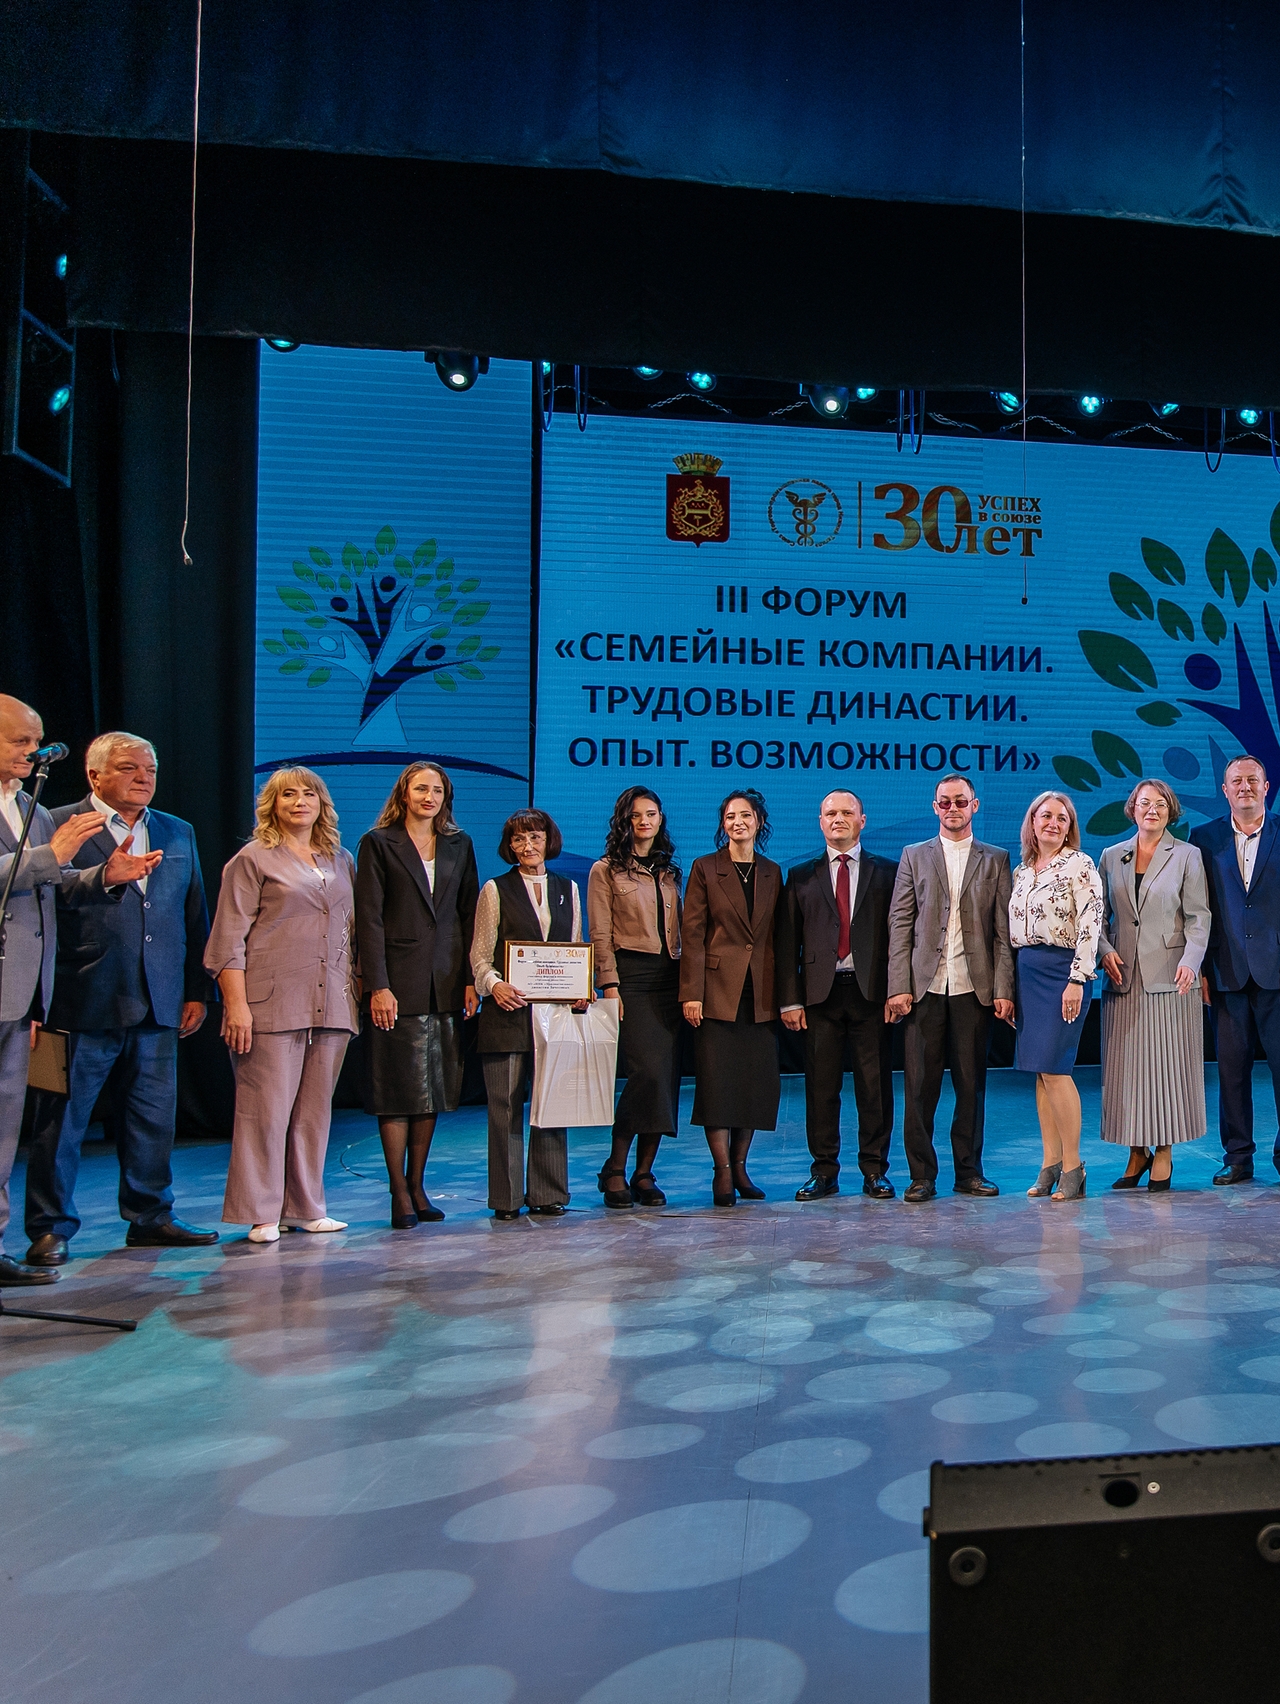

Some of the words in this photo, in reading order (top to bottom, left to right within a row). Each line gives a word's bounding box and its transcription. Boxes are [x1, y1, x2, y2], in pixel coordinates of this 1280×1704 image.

[870, 482, 973, 553] 30
[954, 524, 1043, 557] лет
[977, 494, 1042, 514] УСПЕХ
[716, 585, 748, 614] III
[761, 585, 907, 619] ФОРУМ
[554, 627, 805, 667] «СЕМЕЙНЫЕ
[819, 639, 1053, 673] КОМПАНИИ.
[581, 685, 796, 723] ТРУДОВЫЕ
[806, 690, 1028, 726] ДИНАСТИИ.
[568, 737, 696, 768] ОПЫТ.
[711, 739, 1041, 772] ВОЗМОЖНОСТИ»
